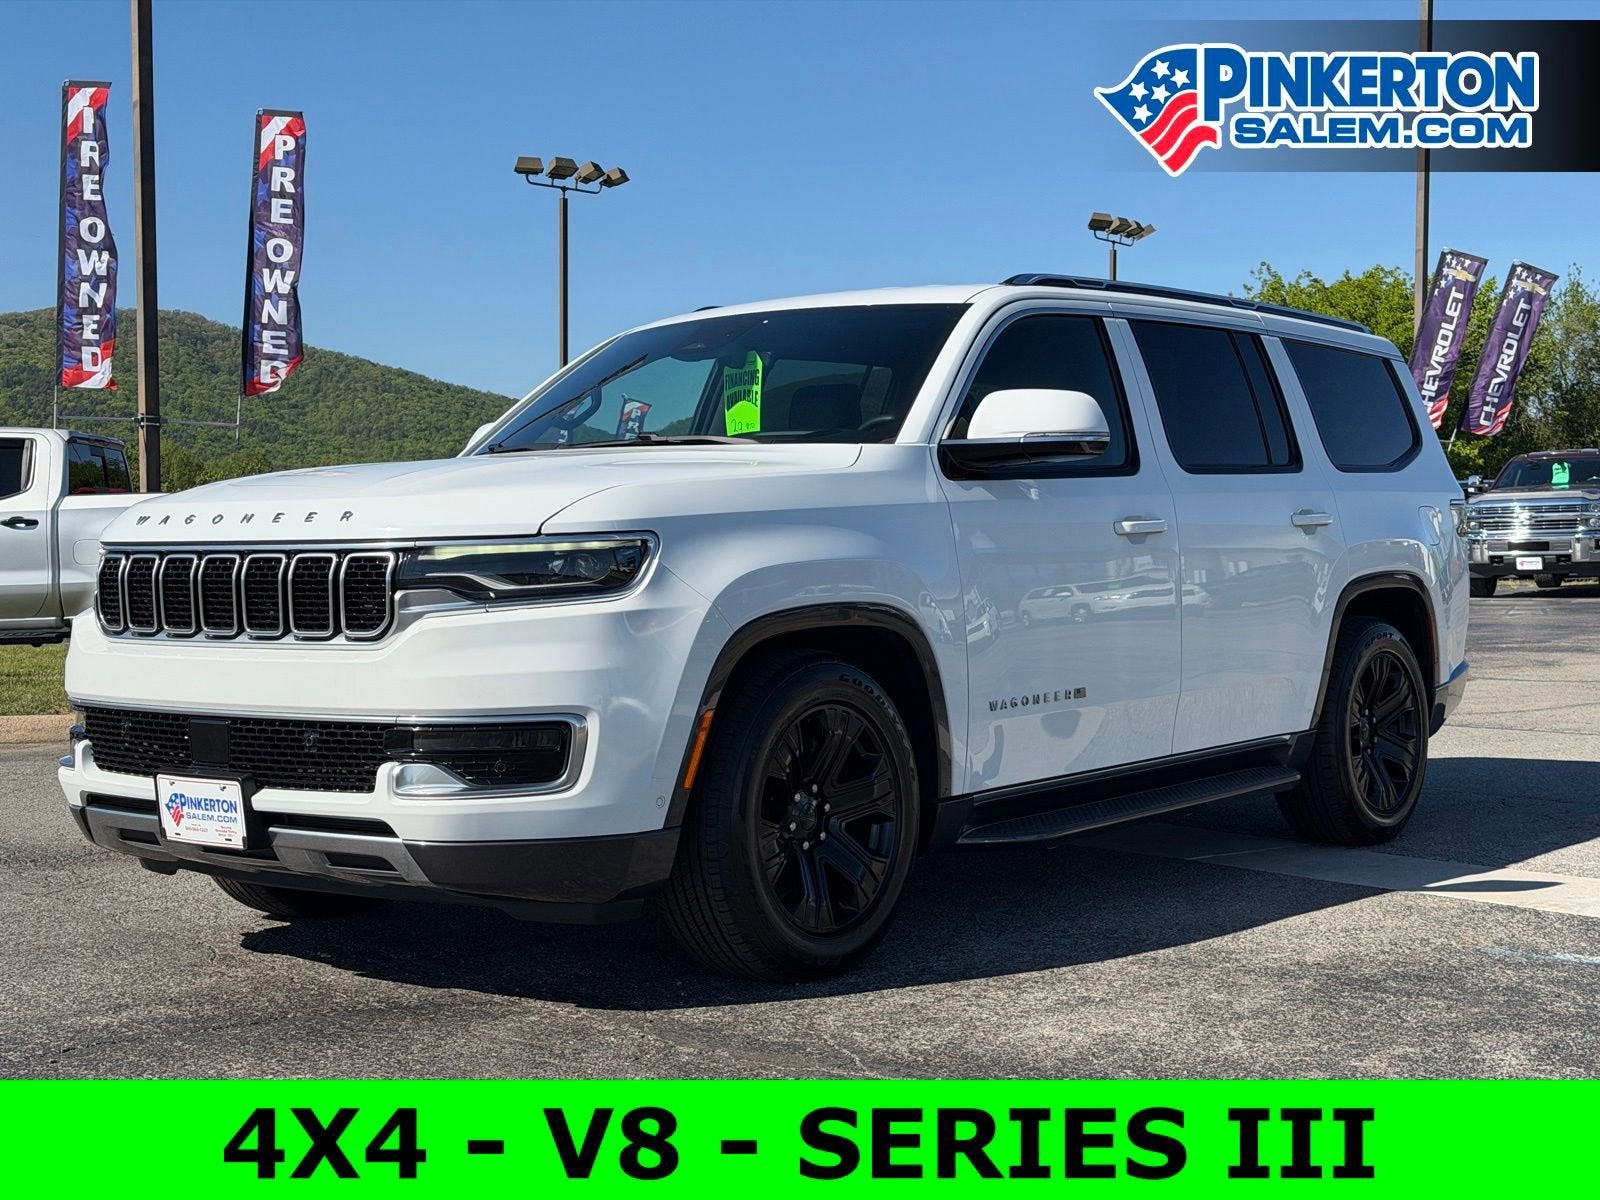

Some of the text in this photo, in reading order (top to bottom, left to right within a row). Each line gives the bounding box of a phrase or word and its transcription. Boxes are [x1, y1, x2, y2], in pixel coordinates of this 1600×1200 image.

[260, 134, 296, 384] PRE OWNED
[77, 216, 109, 372] OWNED
[1479, 297, 1532, 426] CHEVROLET
[725, 368, 760, 392] FINANCING
[726, 389, 759, 411] AVAILABLE
[135, 511, 354, 525] WAGONEER
[988, 689, 1071, 712] WAGONEER
[179, 793, 238, 814] PINKERTON
[186, 812, 238, 824] SALEM.COM
